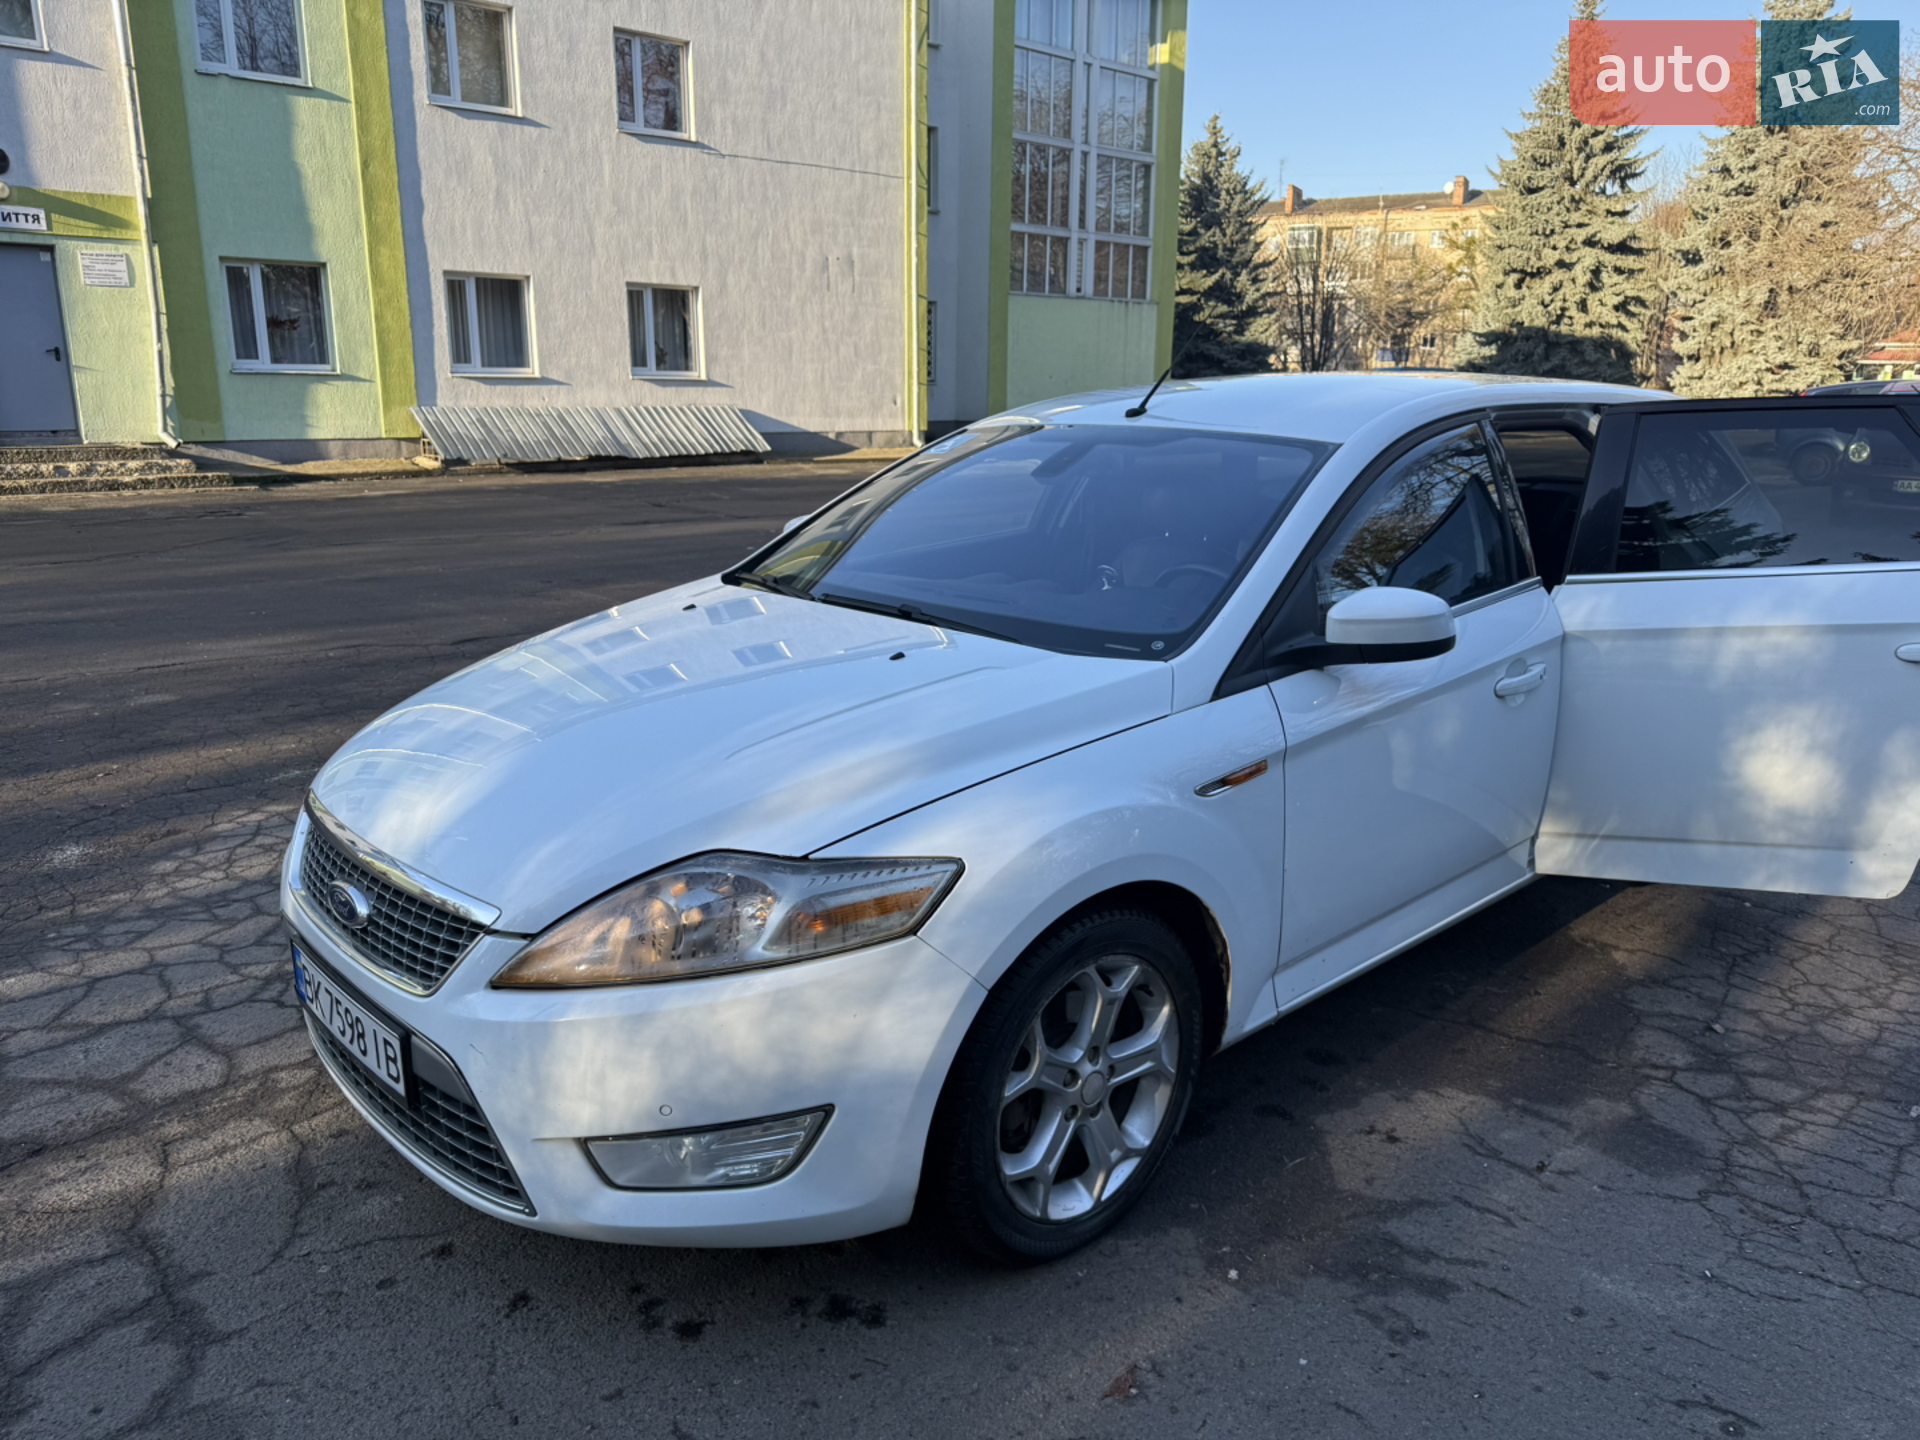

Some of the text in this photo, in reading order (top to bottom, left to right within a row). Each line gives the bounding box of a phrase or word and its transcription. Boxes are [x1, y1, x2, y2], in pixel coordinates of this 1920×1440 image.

[1, 211, 41, 224] ИТТЯ
[324, 986, 368, 1058] 7598
[372, 1028, 401, 1085] IB
